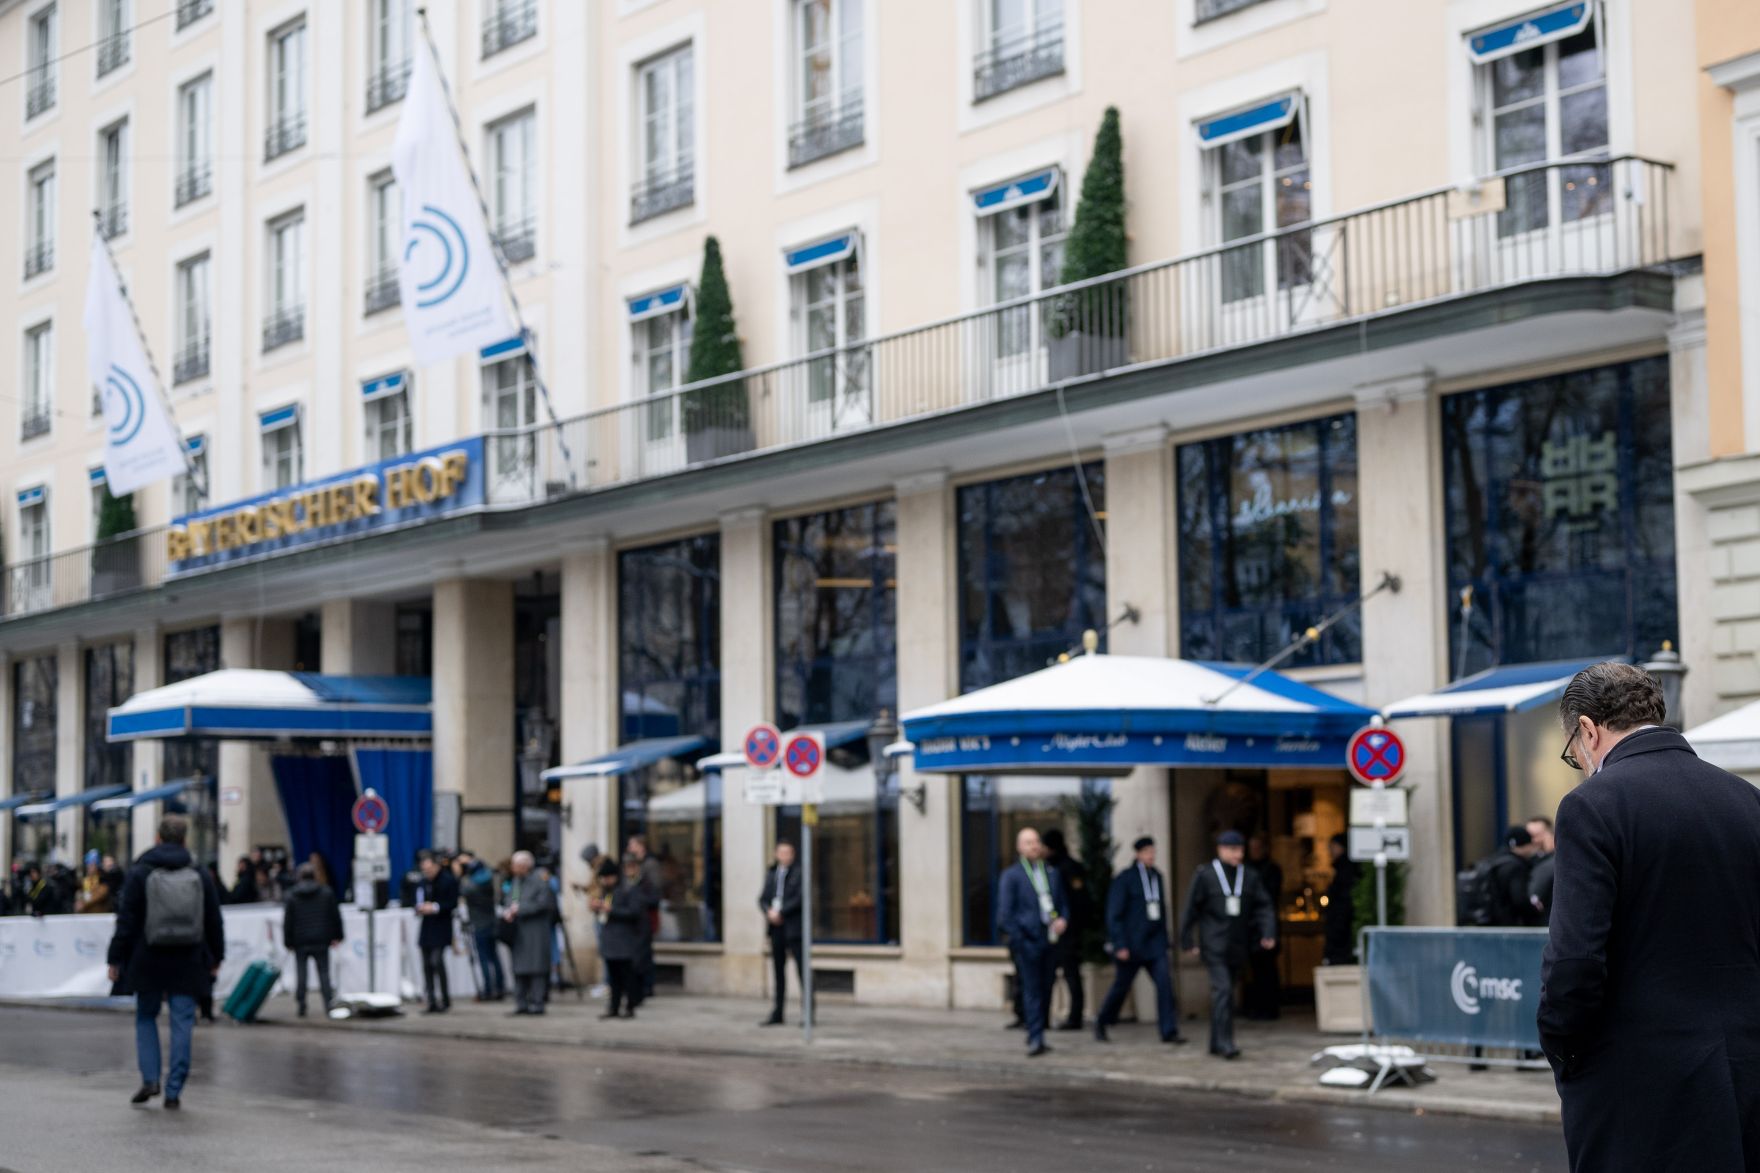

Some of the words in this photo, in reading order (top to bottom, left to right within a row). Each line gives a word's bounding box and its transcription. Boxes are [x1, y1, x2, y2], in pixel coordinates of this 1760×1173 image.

[167, 475, 381, 561] BAYERISCHER
[386, 450, 468, 509] HOF
[1480, 977, 1523, 1000] msc
